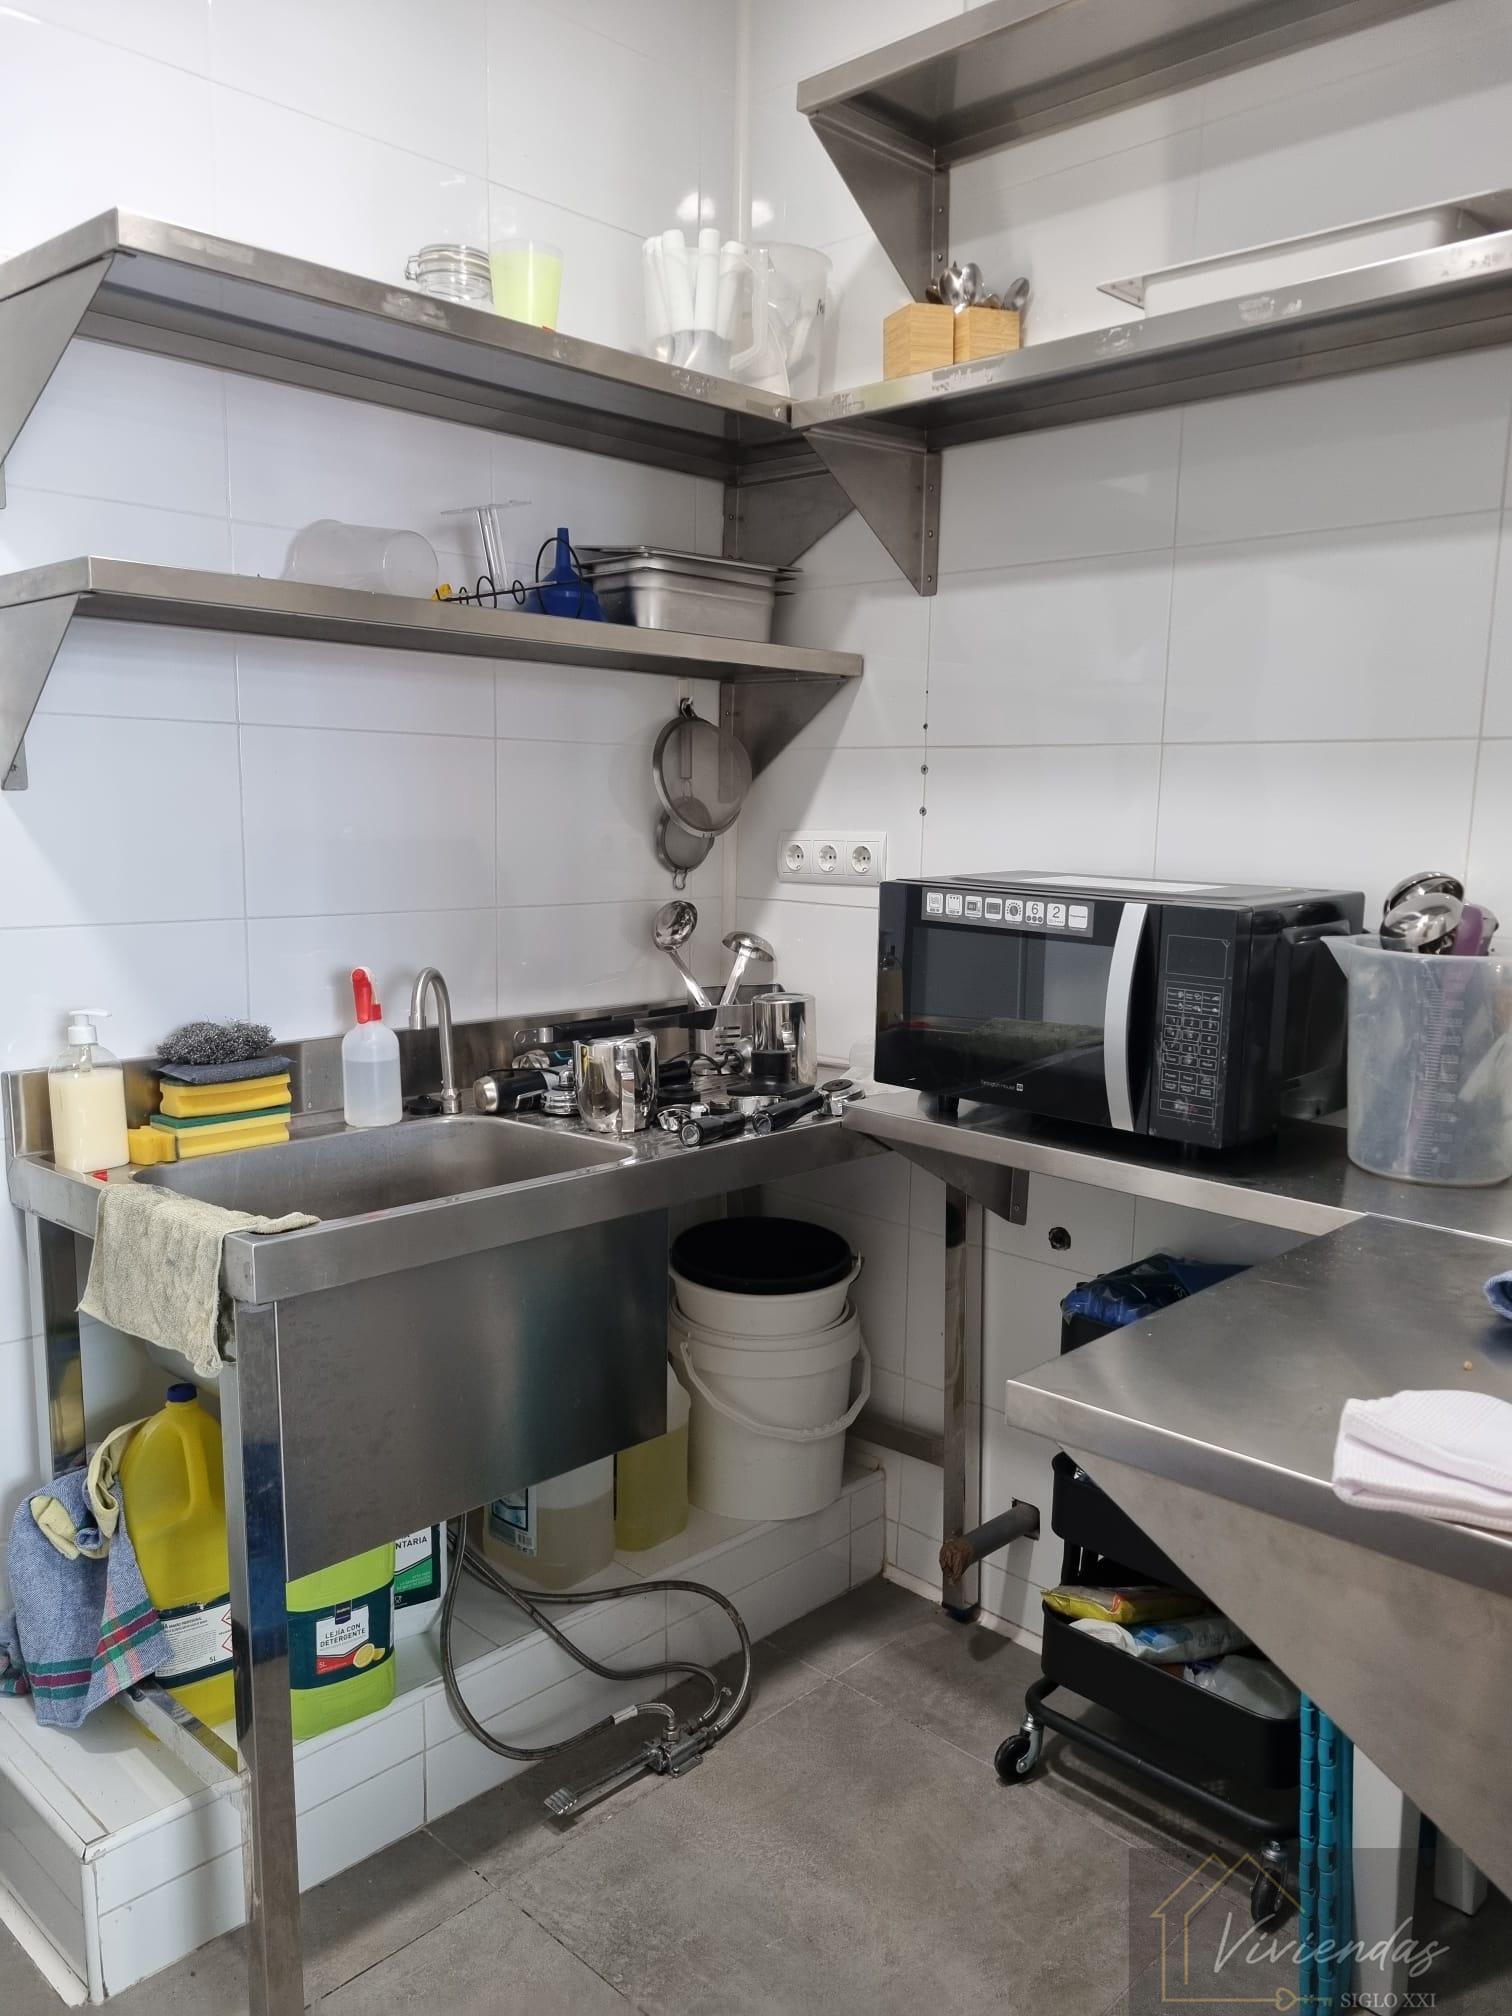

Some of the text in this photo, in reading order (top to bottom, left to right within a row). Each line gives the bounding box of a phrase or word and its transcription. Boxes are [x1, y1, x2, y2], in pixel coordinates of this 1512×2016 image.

[1031, 903, 1039, 915] 6
[1052, 906, 1061, 919] 2
[346, 1622, 361, 1632] CON
[320, 1628, 367, 1648] DETERGENTE
